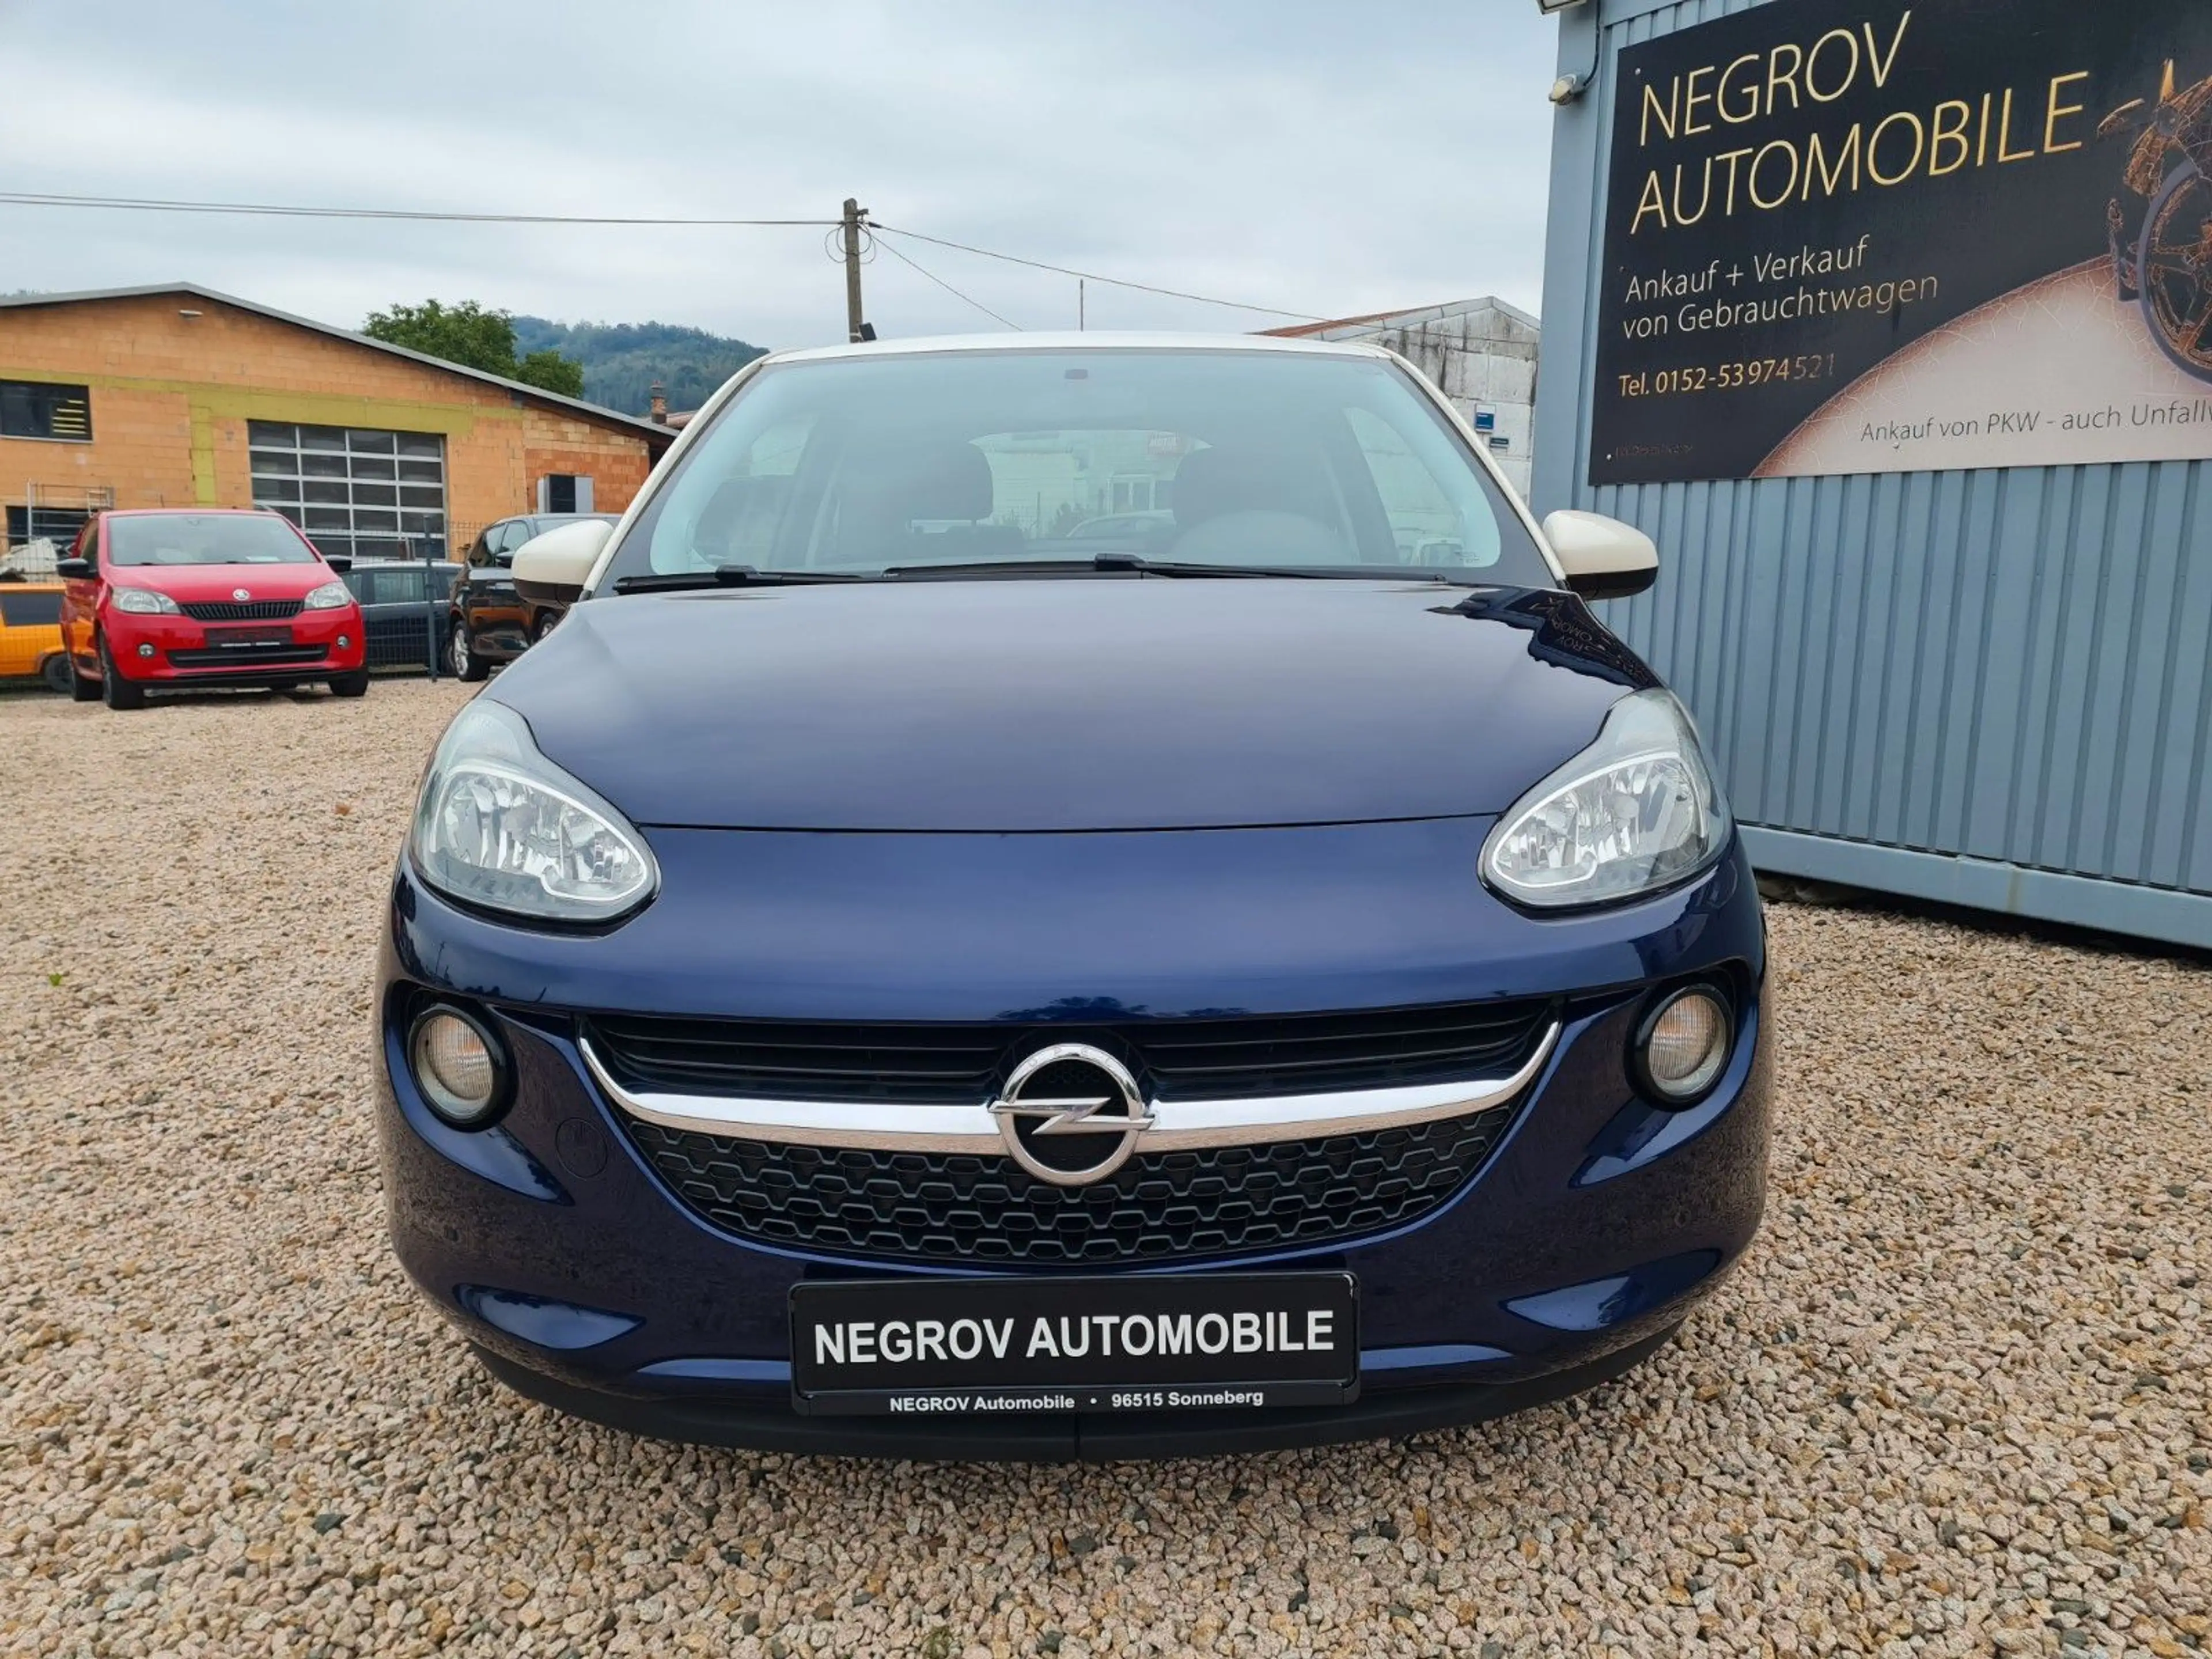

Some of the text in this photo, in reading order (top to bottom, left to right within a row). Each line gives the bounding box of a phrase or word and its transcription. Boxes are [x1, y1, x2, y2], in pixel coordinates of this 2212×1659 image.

[1640, 10, 1911, 146] NEGROV
[1630, 71, 2089, 235] AUTOMOBILE
[1625, 234, 1870, 303] Ankauf + Verkauf
[1623, 275, 1938, 339] von Gebrauchtwagen
[1618, 372, 1649, 397] Tel.
[1860, 417, 1935, 442] Ankauf
[1938, 420, 1979, 437] von
[1987, 410, 2040, 435] PKW
[2061, 405, 2122, 430] auch
[814, 1309, 1334, 1365] NEGROV AUTOMOBILE
[889, 1389, 1264, 1412] NEGROV Automobile 96515 Sonneberg
